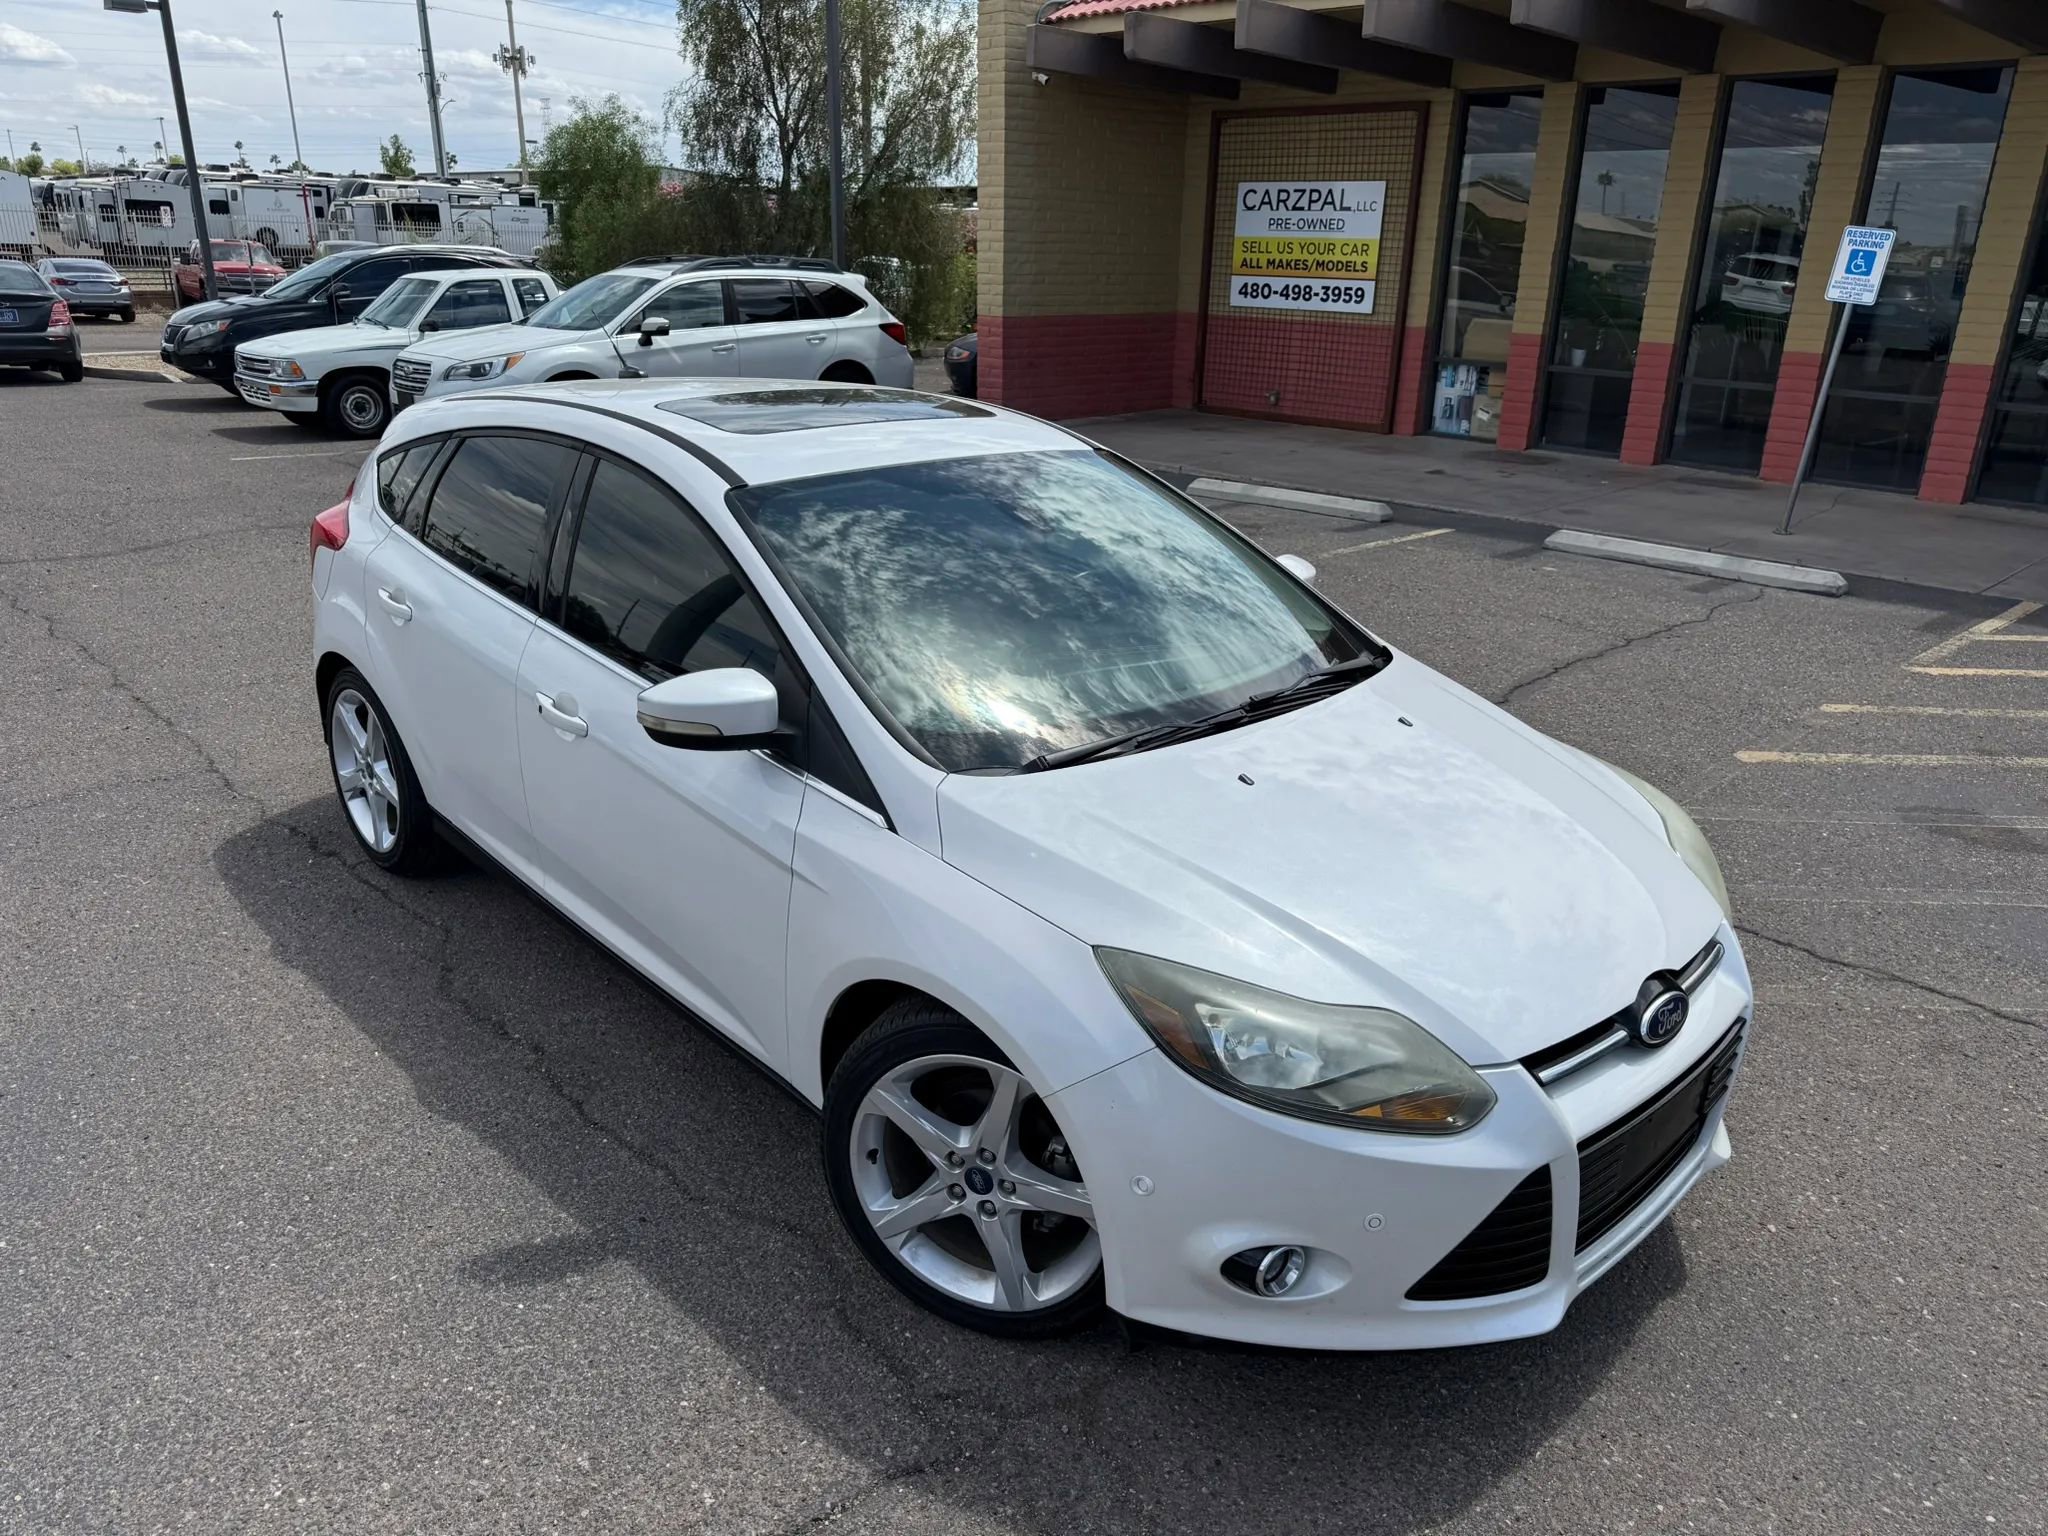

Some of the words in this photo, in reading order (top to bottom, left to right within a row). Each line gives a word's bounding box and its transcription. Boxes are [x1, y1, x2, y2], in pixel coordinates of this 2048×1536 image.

[1268, 217, 1345, 231] PRE-OWNED
[1846, 230, 1891, 241] RESERVED
[1241, 241, 1272, 254] SELL
[1277, 242, 1294, 255] US
[1298, 242, 1336, 256] YOUR
[1340, 243, 1370, 257] CAR
[1847, 239, 1885, 249] PARKING
[1240, 257, 1263, 269] ALL
[1266, 258, 1369, 273] MAKES/MODELS
[1238, 282, 1365, 304] 480-498-3959
[1658, 1001, 1682, 1035] Ford
